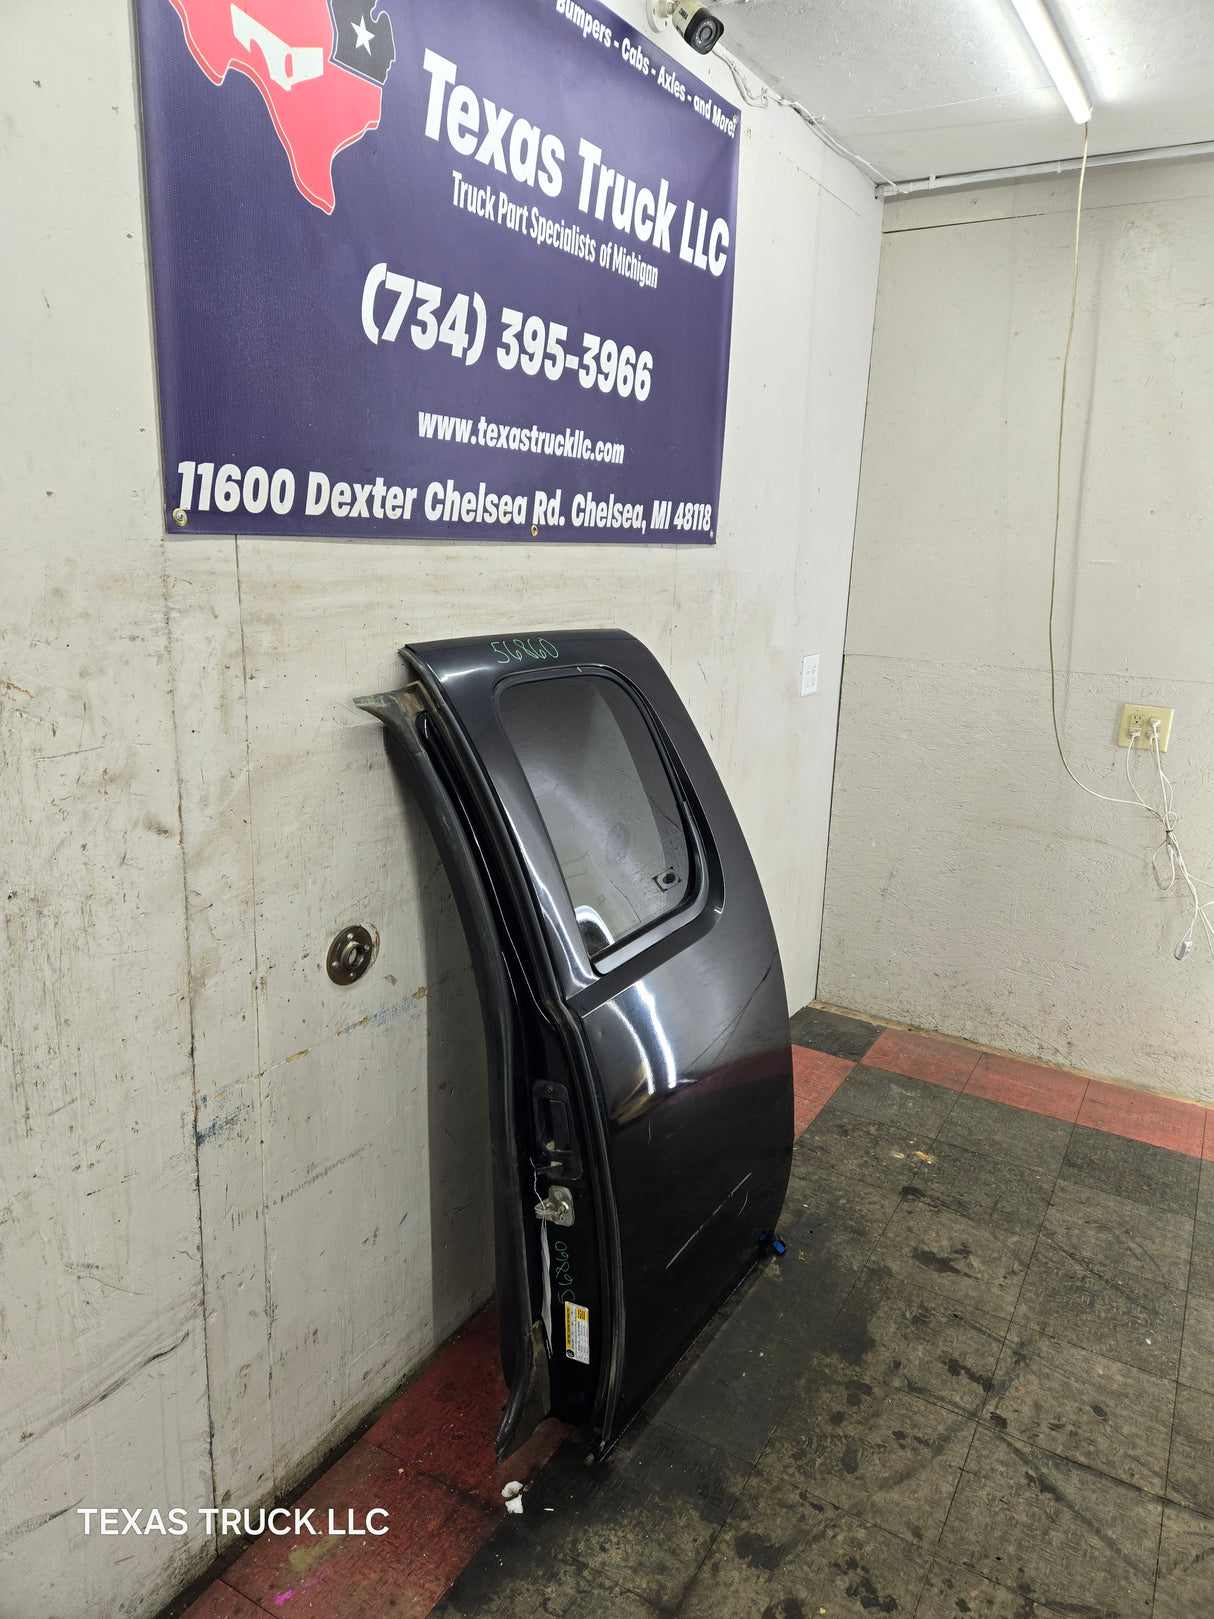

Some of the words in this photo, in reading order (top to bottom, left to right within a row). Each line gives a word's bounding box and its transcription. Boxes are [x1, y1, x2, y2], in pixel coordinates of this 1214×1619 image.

[556, 0, 612, 48] Bumpers
[621, 37, 650, 76] Cabs
[657, 65, 686, 102] Axles
[693, 95, 712, 120] and
[712, 104, 737, 138] More!
[423, 47, 565, 198] Texas
[578, 137, 678, 253] Truck
[679, 199, 730, 277] LLC
[452, 169, 495, 221] Truck
[497, 191, 529, 235] Part
[529, 206, 597, 263] Specialists
[599, 241, 613, 267] of
[612, 243, 659, 289] Michigan
[361, 262, 487, 366] (734)
[496, 306, 653, 402] 395-3966
[418, 411, 624, 465] www.texastruckllc.com
[177, 460, 296, 515] 11600
[305, 471, 418, 520] Dexter
[424, 479, 528, 525] Chelsea
[532, 488, 566, 526] Rd.
[571, 491, 647, 535] Chelsea,
[650, 500, 673, 530] MI
[673, 502, 712, 531] 48118
[490, 637, 559, 664] 56860
[554, 1240, 576, 1304] 56860
